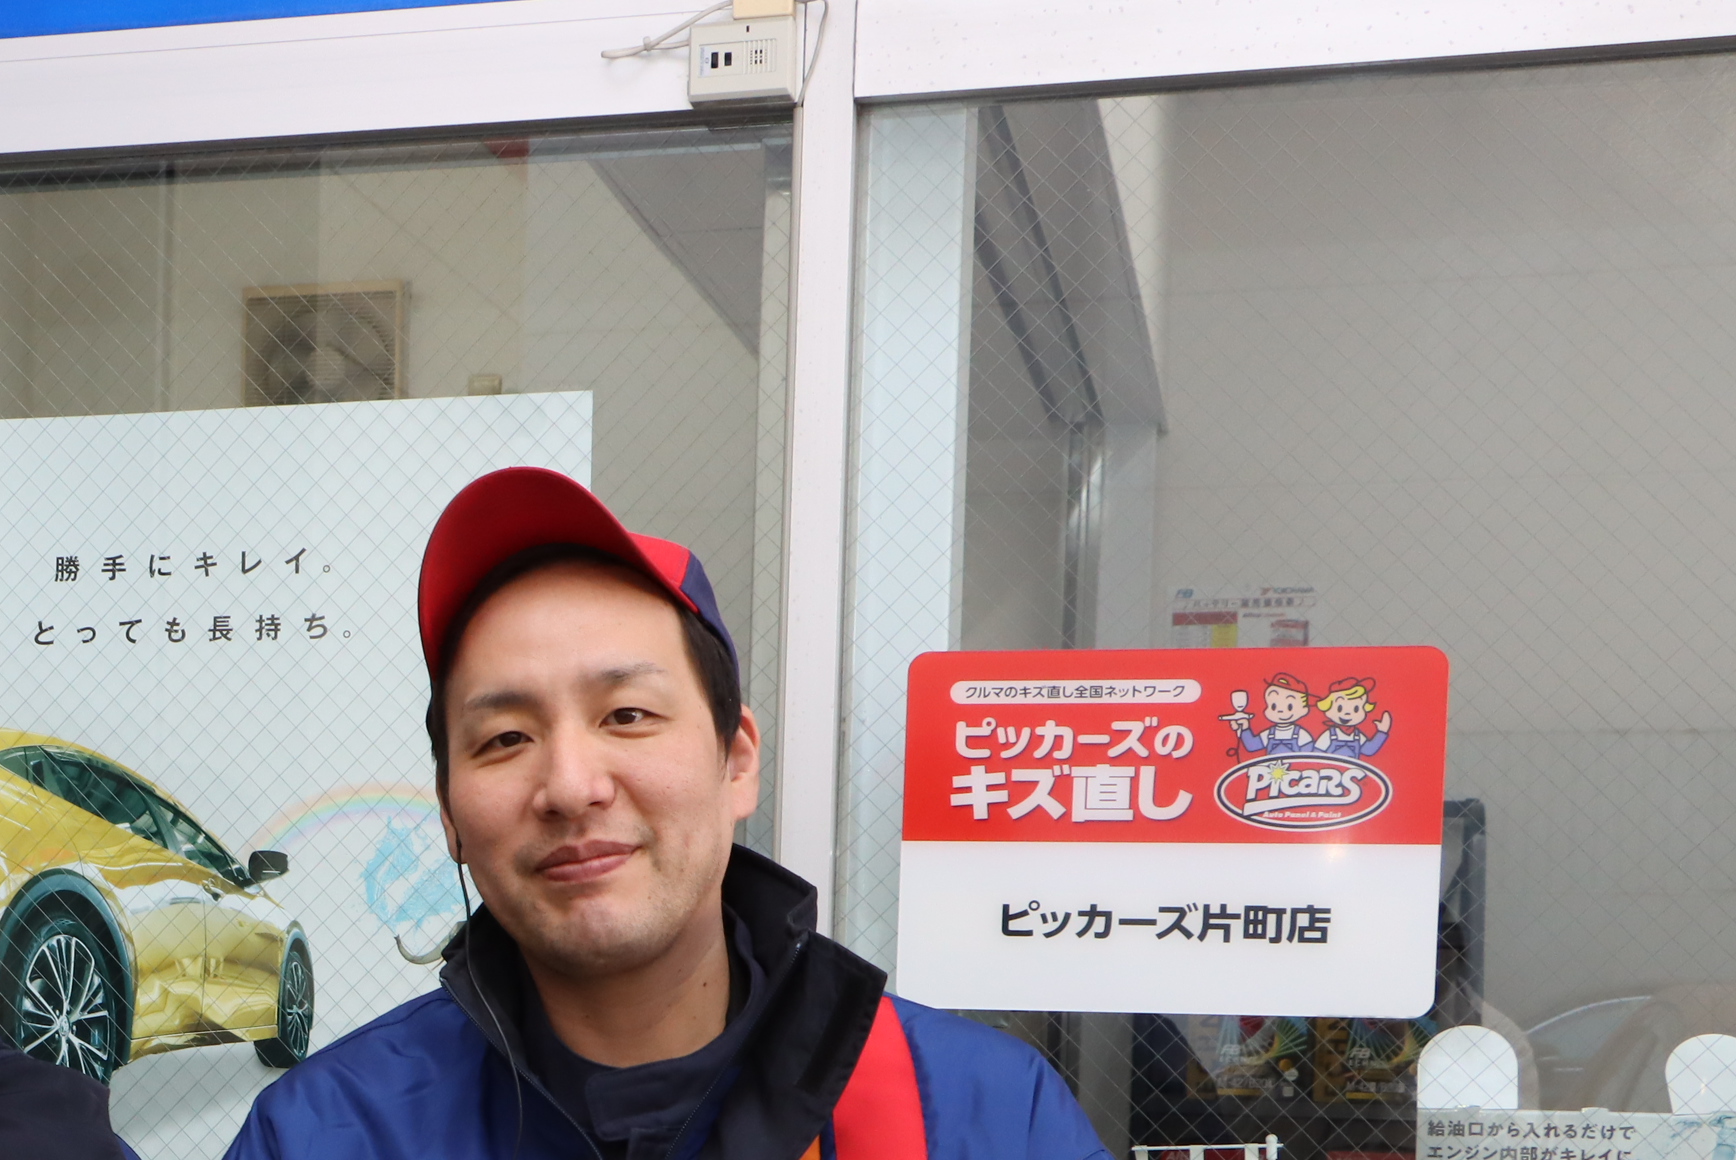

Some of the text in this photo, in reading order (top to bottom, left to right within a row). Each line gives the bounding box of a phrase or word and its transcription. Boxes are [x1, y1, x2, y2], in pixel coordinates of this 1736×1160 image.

[54, 547, 332, 582] 勝手にキレイ。
[32, 612, 352, 646] とっても長持ち。
[965, 685, 1186, 699] クルマのキズ直し全国ネットワーク
[955, 716, 1194, 760] ピッカーズの
[949, 763, 1194, 823] キズ直し
[1262, 811, 1342, 819] Auto Panel & Paint
[1001, 900, 1332, 944] ピッカーズ片町店
[1427, 1119, 1636, 1141] 給油口から入れるだけで
